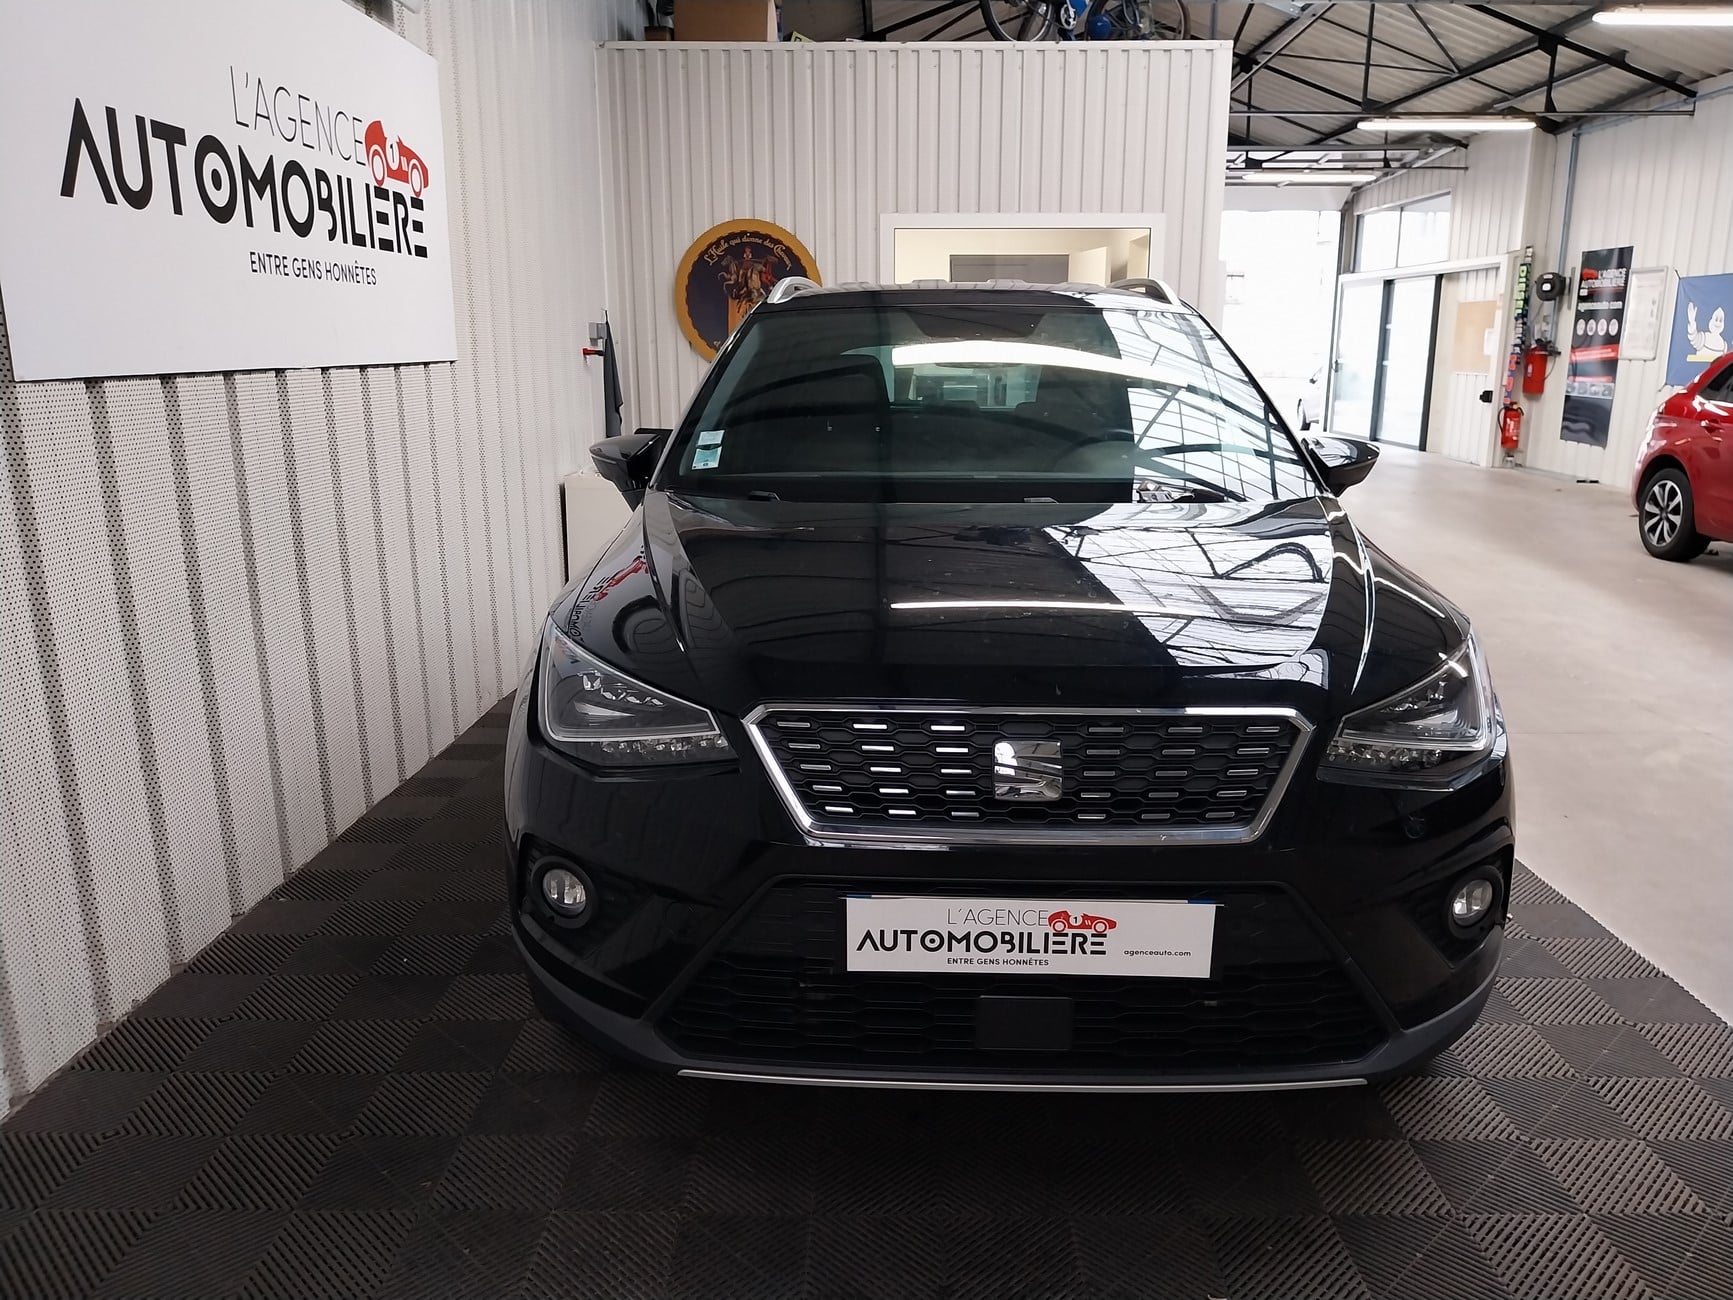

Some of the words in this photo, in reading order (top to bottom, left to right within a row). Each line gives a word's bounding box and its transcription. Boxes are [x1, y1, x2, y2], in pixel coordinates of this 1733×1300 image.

[230, 65, 366, 166] L'AGENCE
[60, 97, 428, 258] AUTOMOBILIERE
[249, 251, 290, 276] ENTRE
[292, 257, 323, 279] GENS
[324, 260, 377, 285] HONNÊTES
[947, 908, 1049, 926] L'AGENCE
[856, 929, 1107, 955] AUTOMOBILIERE
[1123, 949, 1191, 957] agenceauto.com
[947, 957, 975, 965] ENTRE
[976, 957, 1000, 966] GENS
[1002, 956, 1049, 966] HONNÊTES
